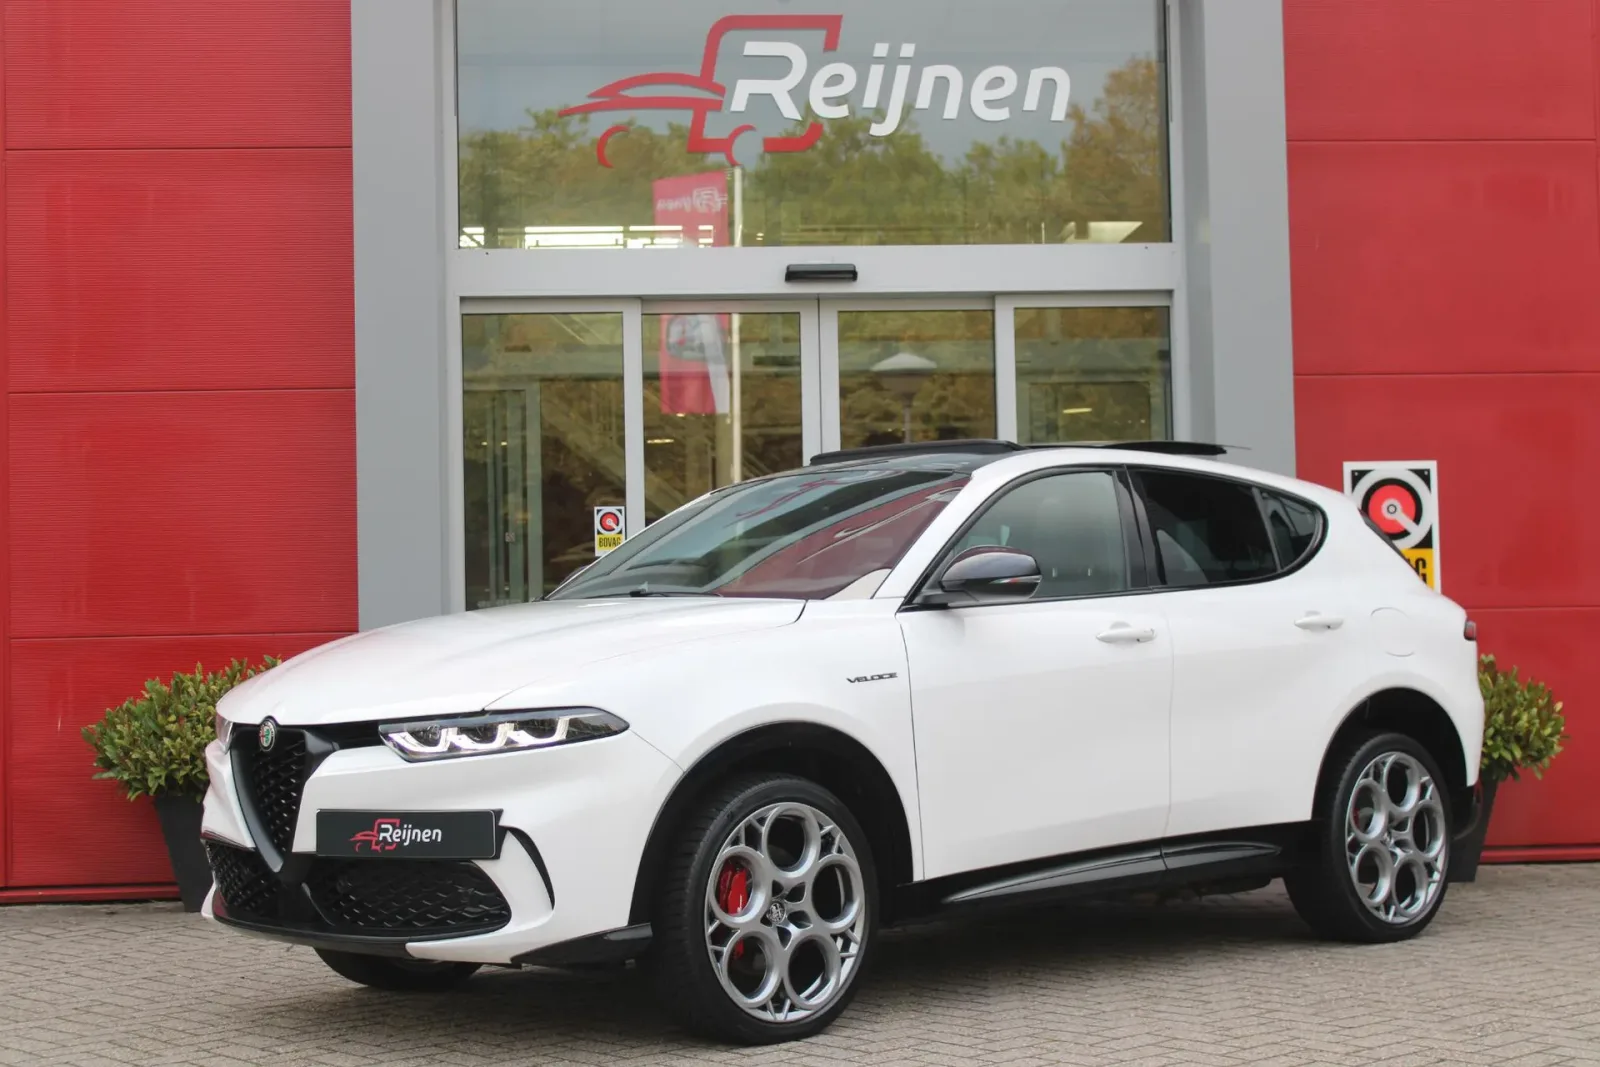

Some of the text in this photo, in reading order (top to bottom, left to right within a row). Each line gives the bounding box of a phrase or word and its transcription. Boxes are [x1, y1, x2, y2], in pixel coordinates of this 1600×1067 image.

[730, 41, 1070, 136] Reijnen
[846, 672, 898, 683] VELOCE
[379, 824, 442, 846] Reijnen
